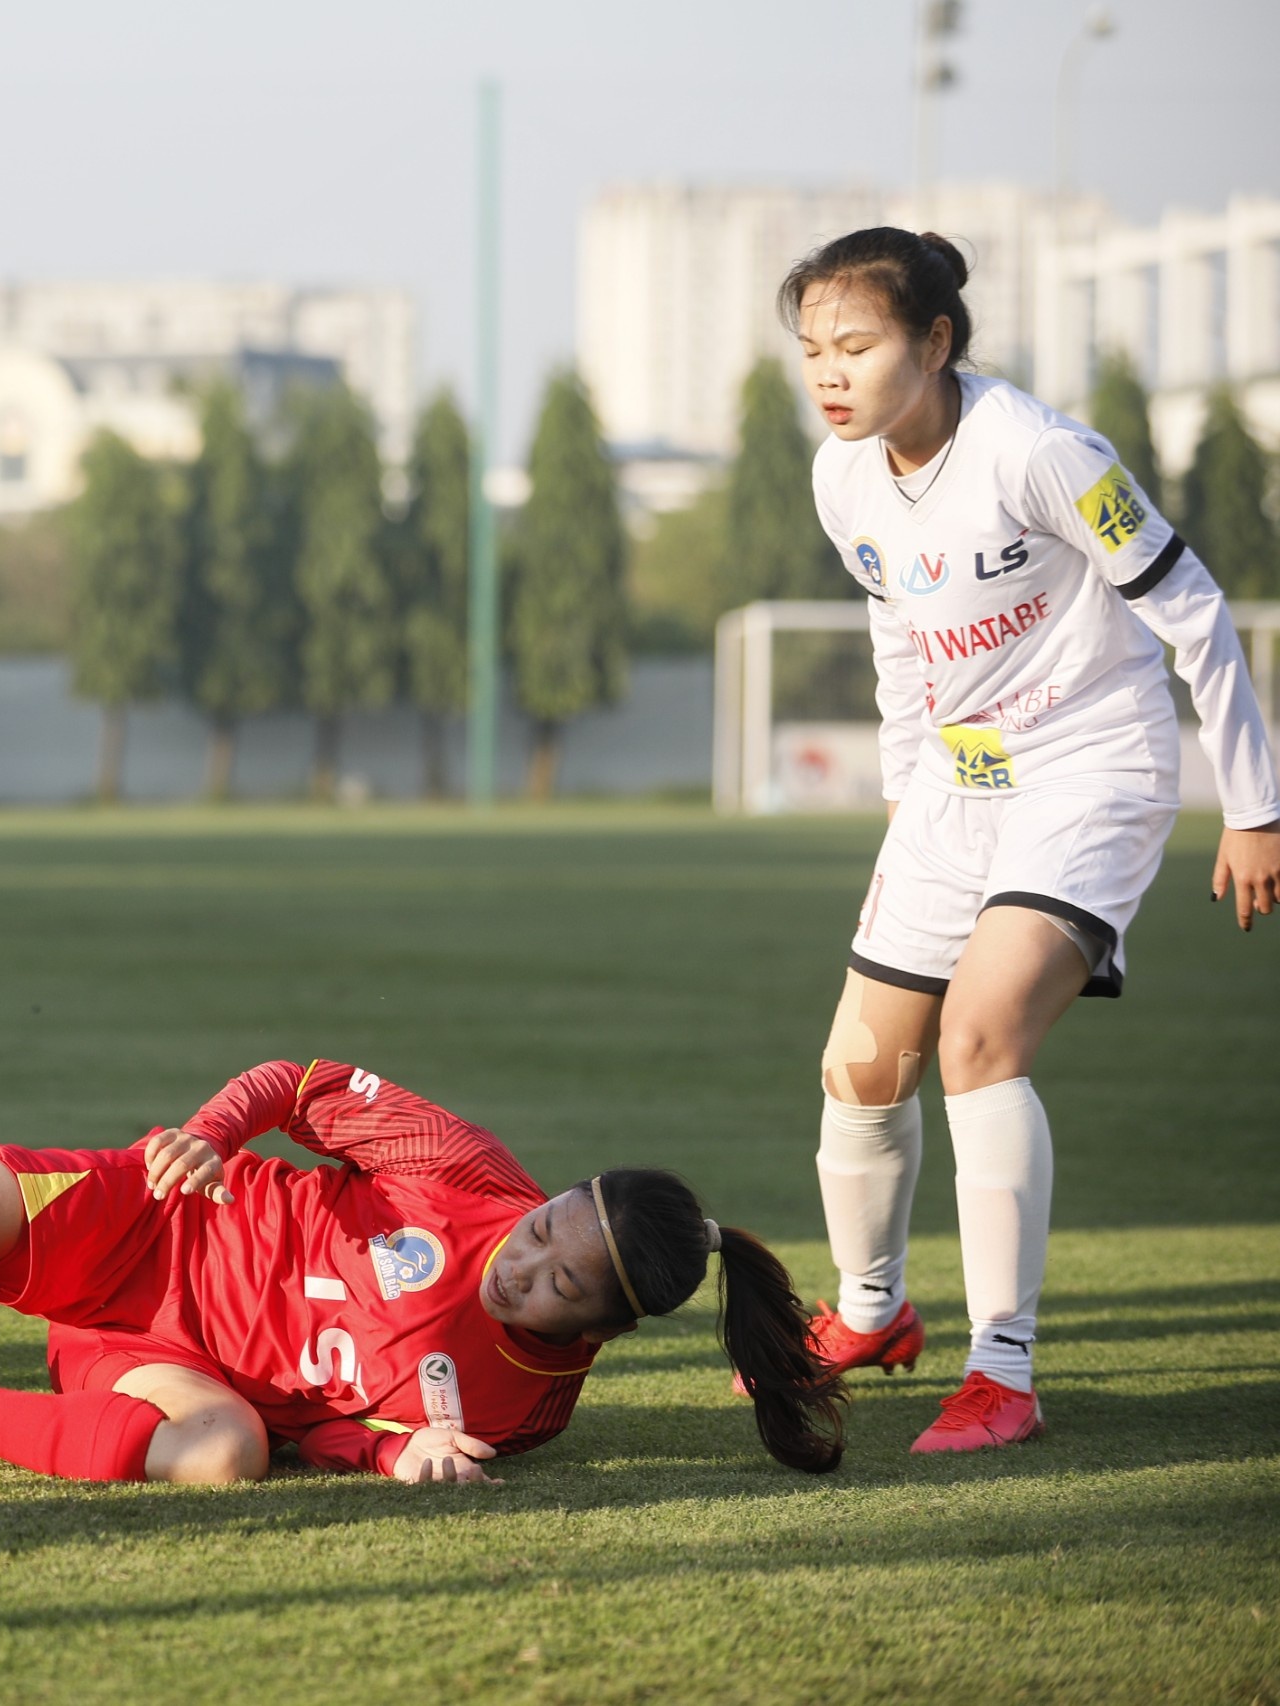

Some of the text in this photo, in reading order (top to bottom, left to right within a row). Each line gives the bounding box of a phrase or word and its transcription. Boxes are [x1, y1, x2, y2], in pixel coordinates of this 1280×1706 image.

[1100, 499, 1145, 546] TSB
[974, 537, 1029, 581] LS
[934, 591, 1053, 661] WATABE
